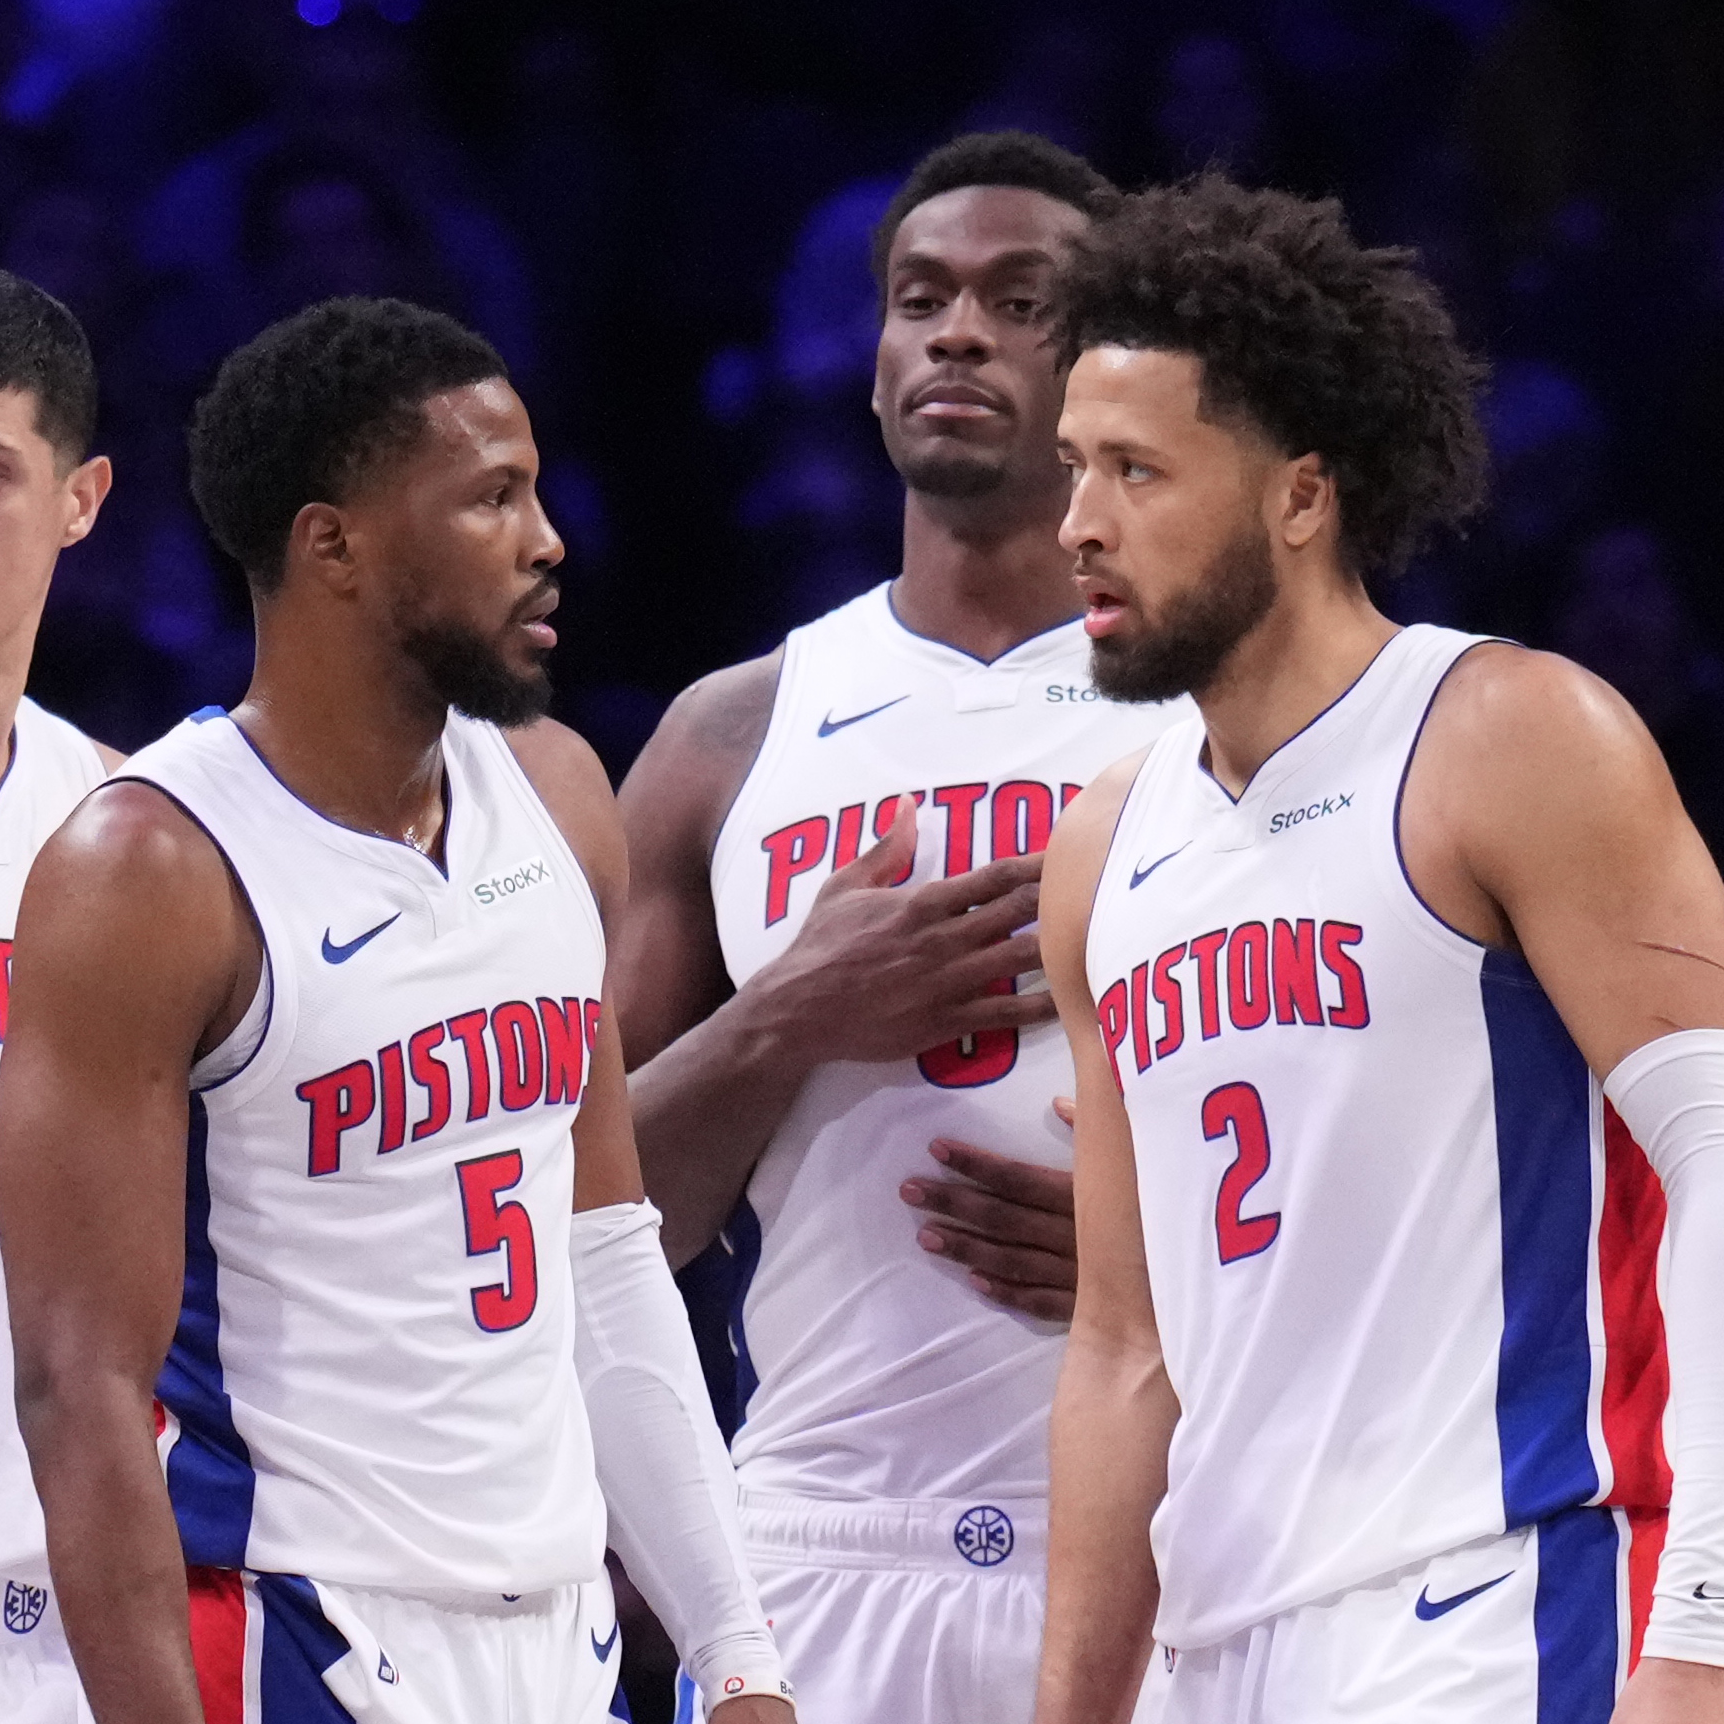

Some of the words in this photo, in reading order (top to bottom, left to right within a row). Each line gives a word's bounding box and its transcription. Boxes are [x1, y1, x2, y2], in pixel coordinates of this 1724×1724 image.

[474, 859, 550, 905] StockX
[761, 780, 1085, 929] PITO
[1269, 790, 1356, 834] StockX
[1097, 917, 1370, 1101] PISTONS
[455, 1147, 539, 1333] 5
[1201, 1081, 1280, 1264] 2
